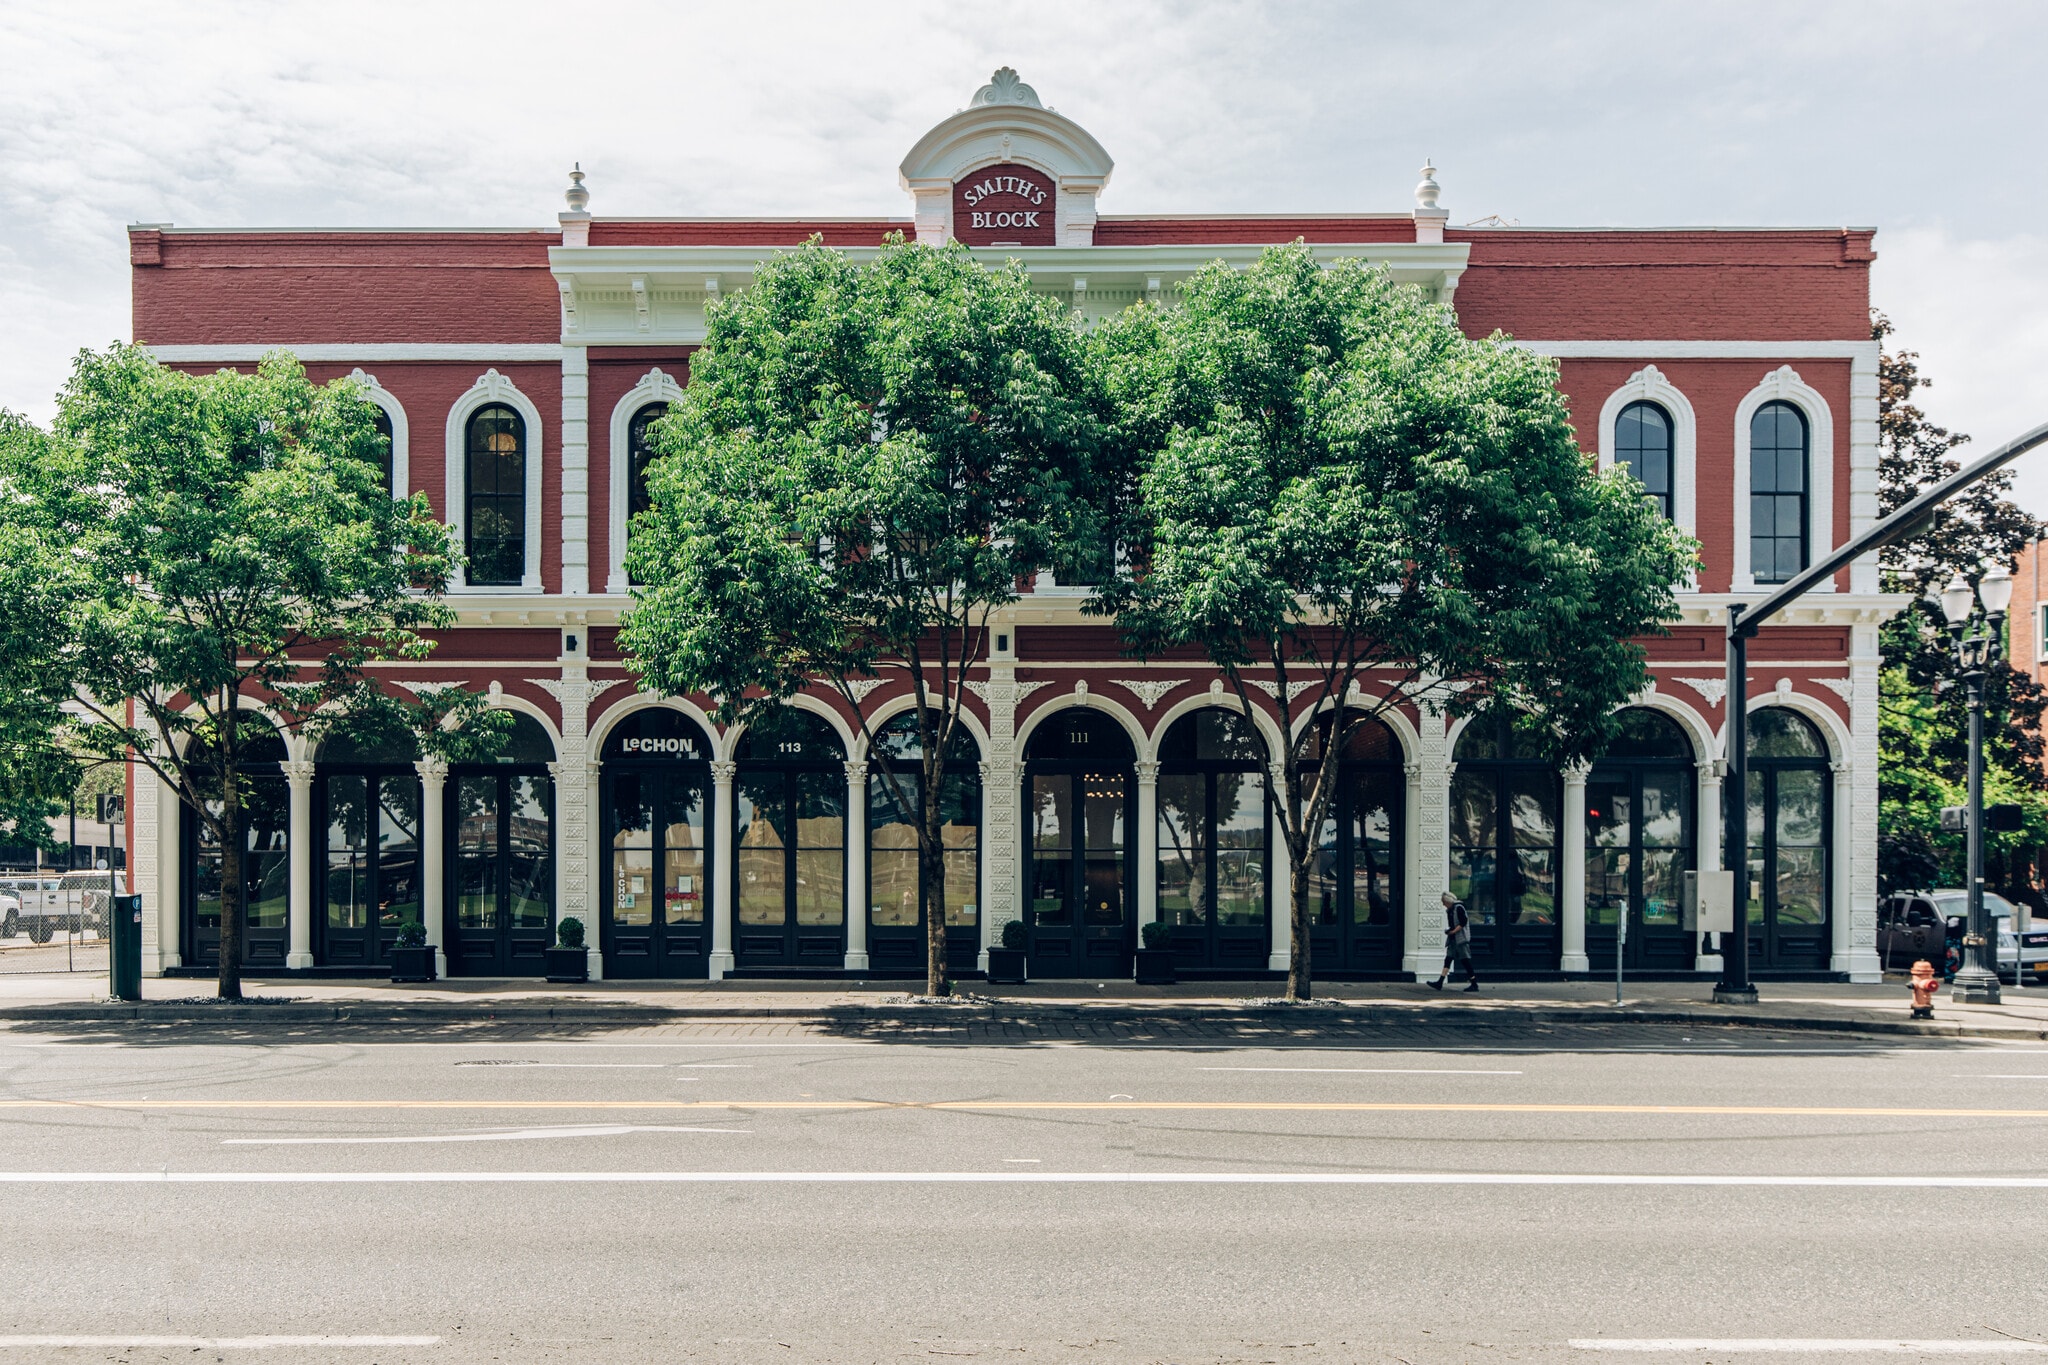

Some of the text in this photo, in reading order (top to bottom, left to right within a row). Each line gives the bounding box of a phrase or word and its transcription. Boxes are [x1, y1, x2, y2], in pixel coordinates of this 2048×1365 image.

[964, 176, 1047, 207] SMITH'S
[971, 212, 1040, 228] BLOCK
[1070, 732, 1088, 743] 111
[623, 738, 693, 752] LeCHON
[778, 742, 802, 753] 113
